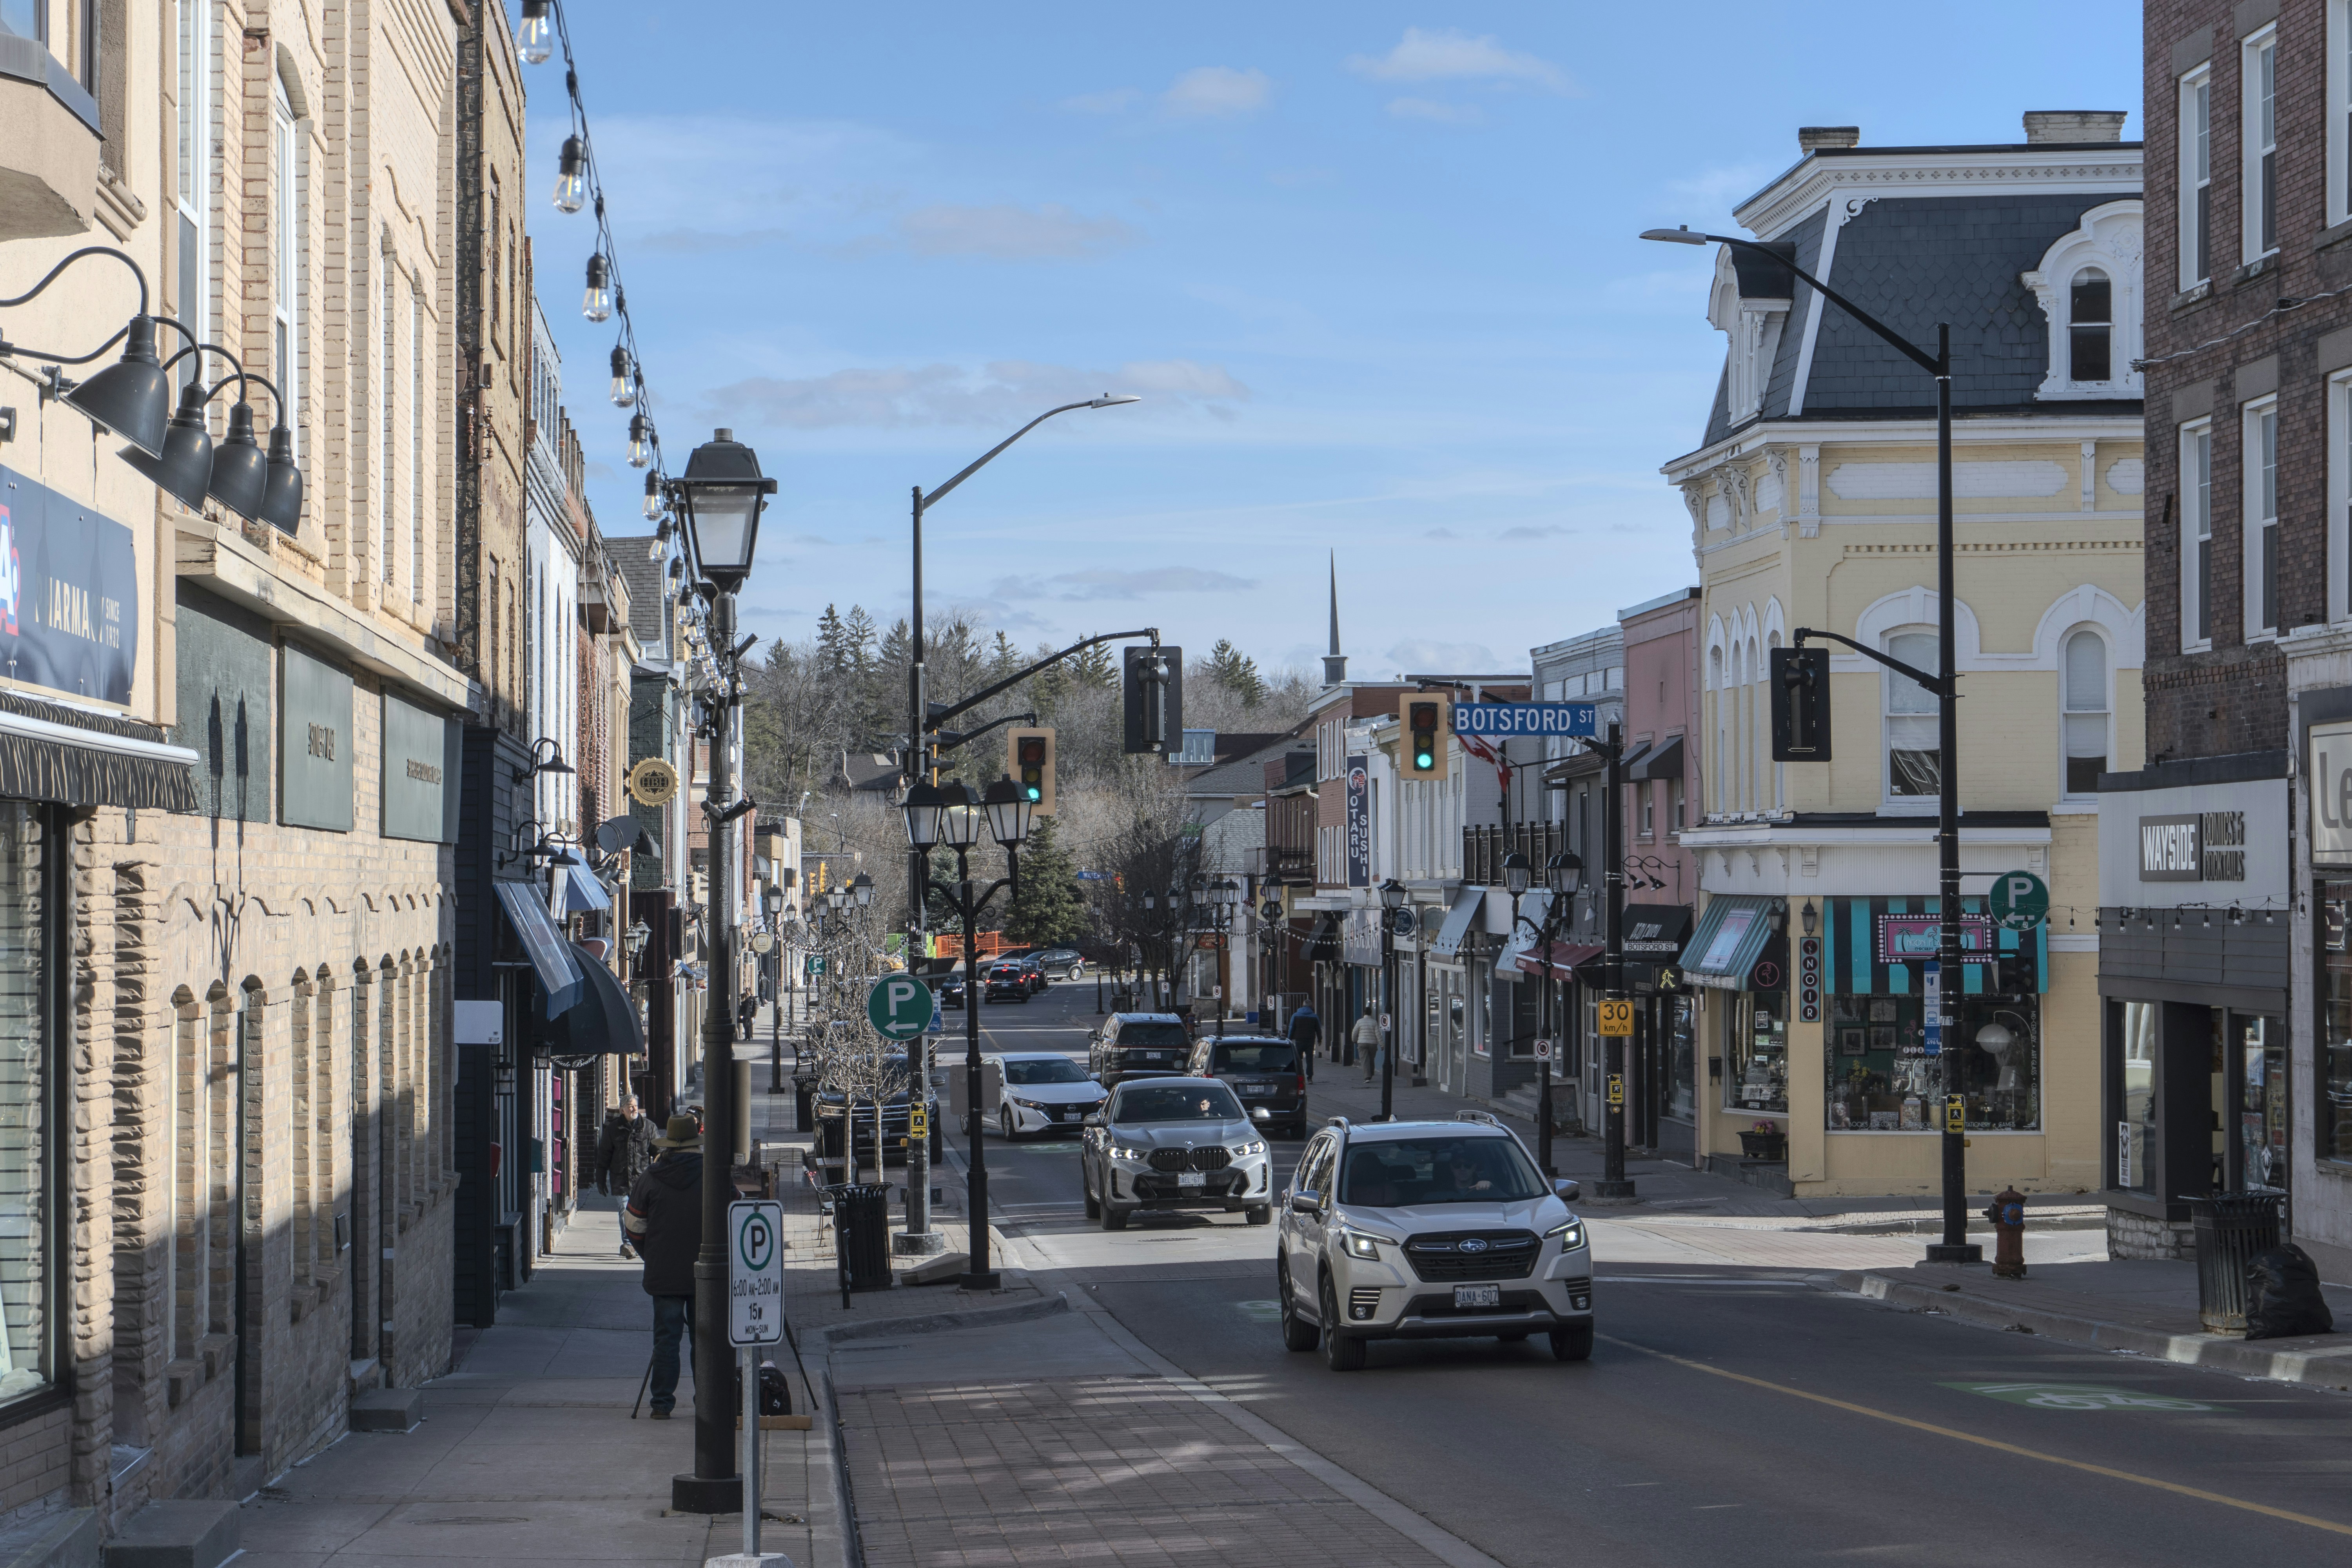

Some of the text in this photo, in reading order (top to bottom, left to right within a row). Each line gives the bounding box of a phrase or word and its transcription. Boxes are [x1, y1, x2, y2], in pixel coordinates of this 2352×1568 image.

[36, 573, 104, 642] PHARMACY
[106, 597, 119, 622] SINCE
[106, 625, 119, 649] 1932
[1457, 708, 1593, 731] BOTSFORD ST
[641, 778, 668, 787] HBH
[1350, 796, 1359, 858] OTARU
[2203, 811, 2244, 846] COMICS &
[2143, 824, 2195, 871] WAYSIDE
[2205, 850, 2245, 881] COCKTAILS
[2008, 878, 2033, 908] P
[888, 982, 916, 1016] P
[1806, 959, 1814, 1017] NOIR
[1603, 1004, 1629, 1020] 30
[1604, 1023, 1627, 1033] km/h
[751, 1225, 766, 1259] P
[733, 1279, 747, 1297] 6:00
[773, 1281, 779, 1294] AM
[1456, 1290, 1497, 1302] DANA 607
[745, 1324, 768, 1335] MON-SUN
